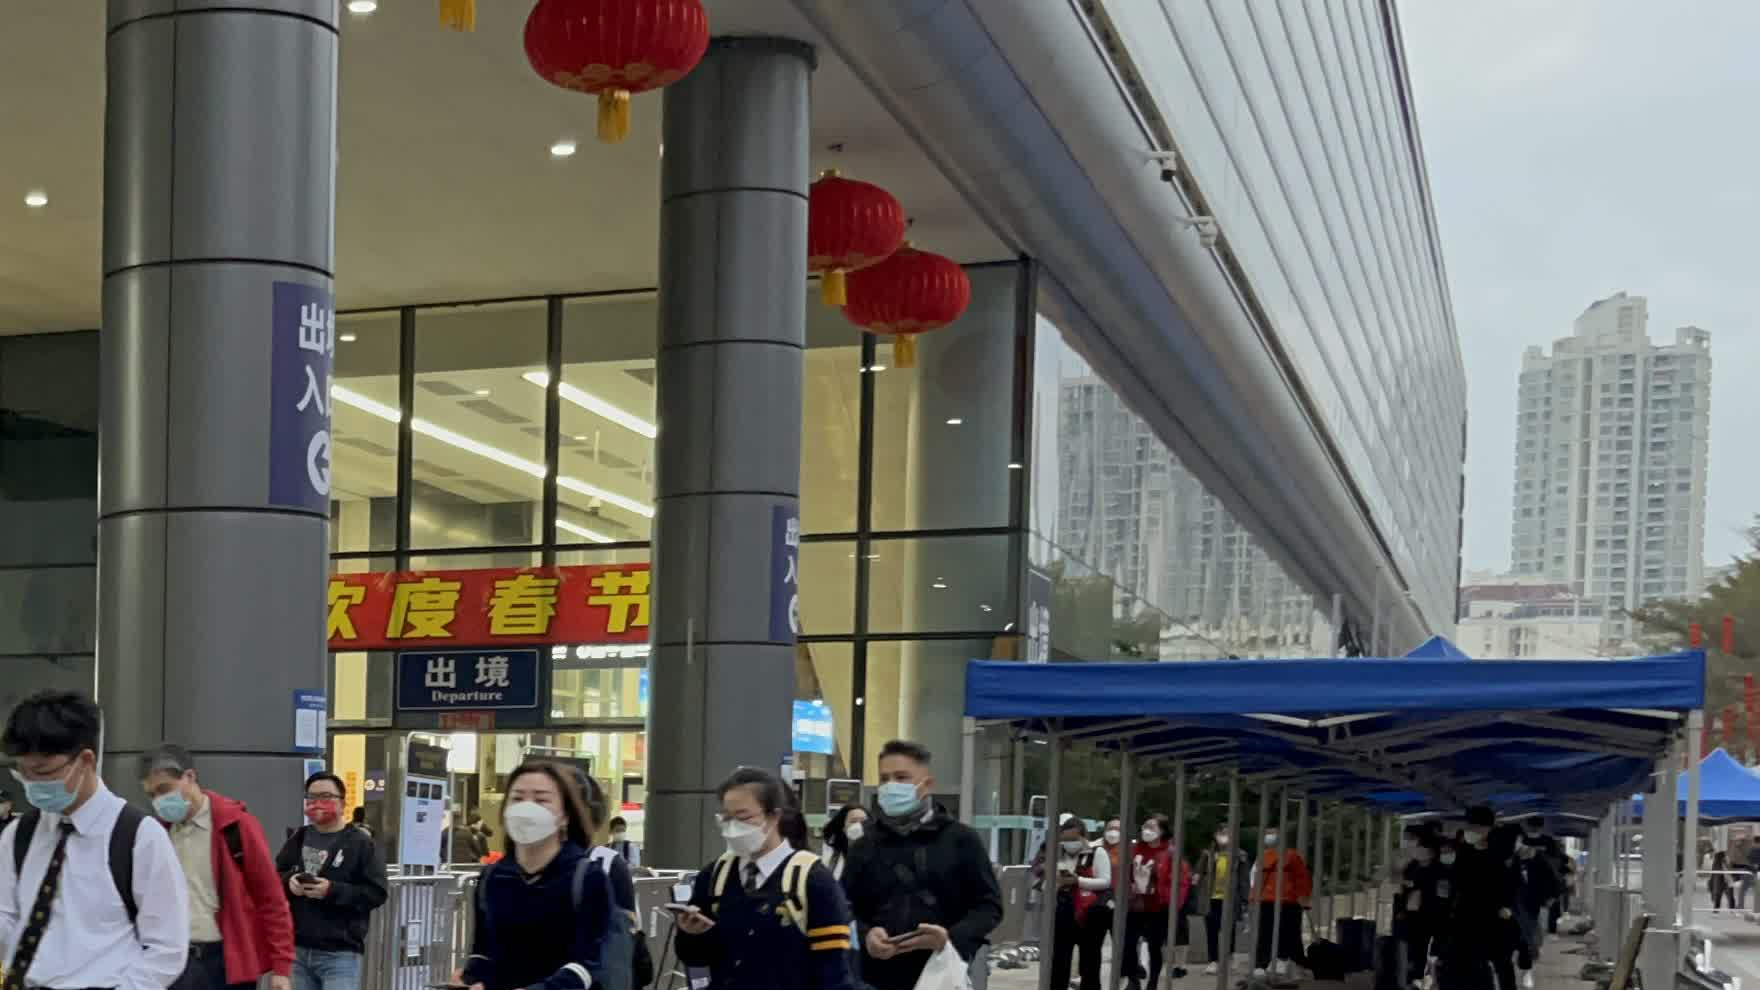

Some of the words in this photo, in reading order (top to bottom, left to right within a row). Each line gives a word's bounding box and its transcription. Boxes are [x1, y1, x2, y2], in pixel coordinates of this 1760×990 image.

[298, 303, 333, 355] 出
[424, 656, 511, 688] 出境
[431, 689, 503, 704] Departure
